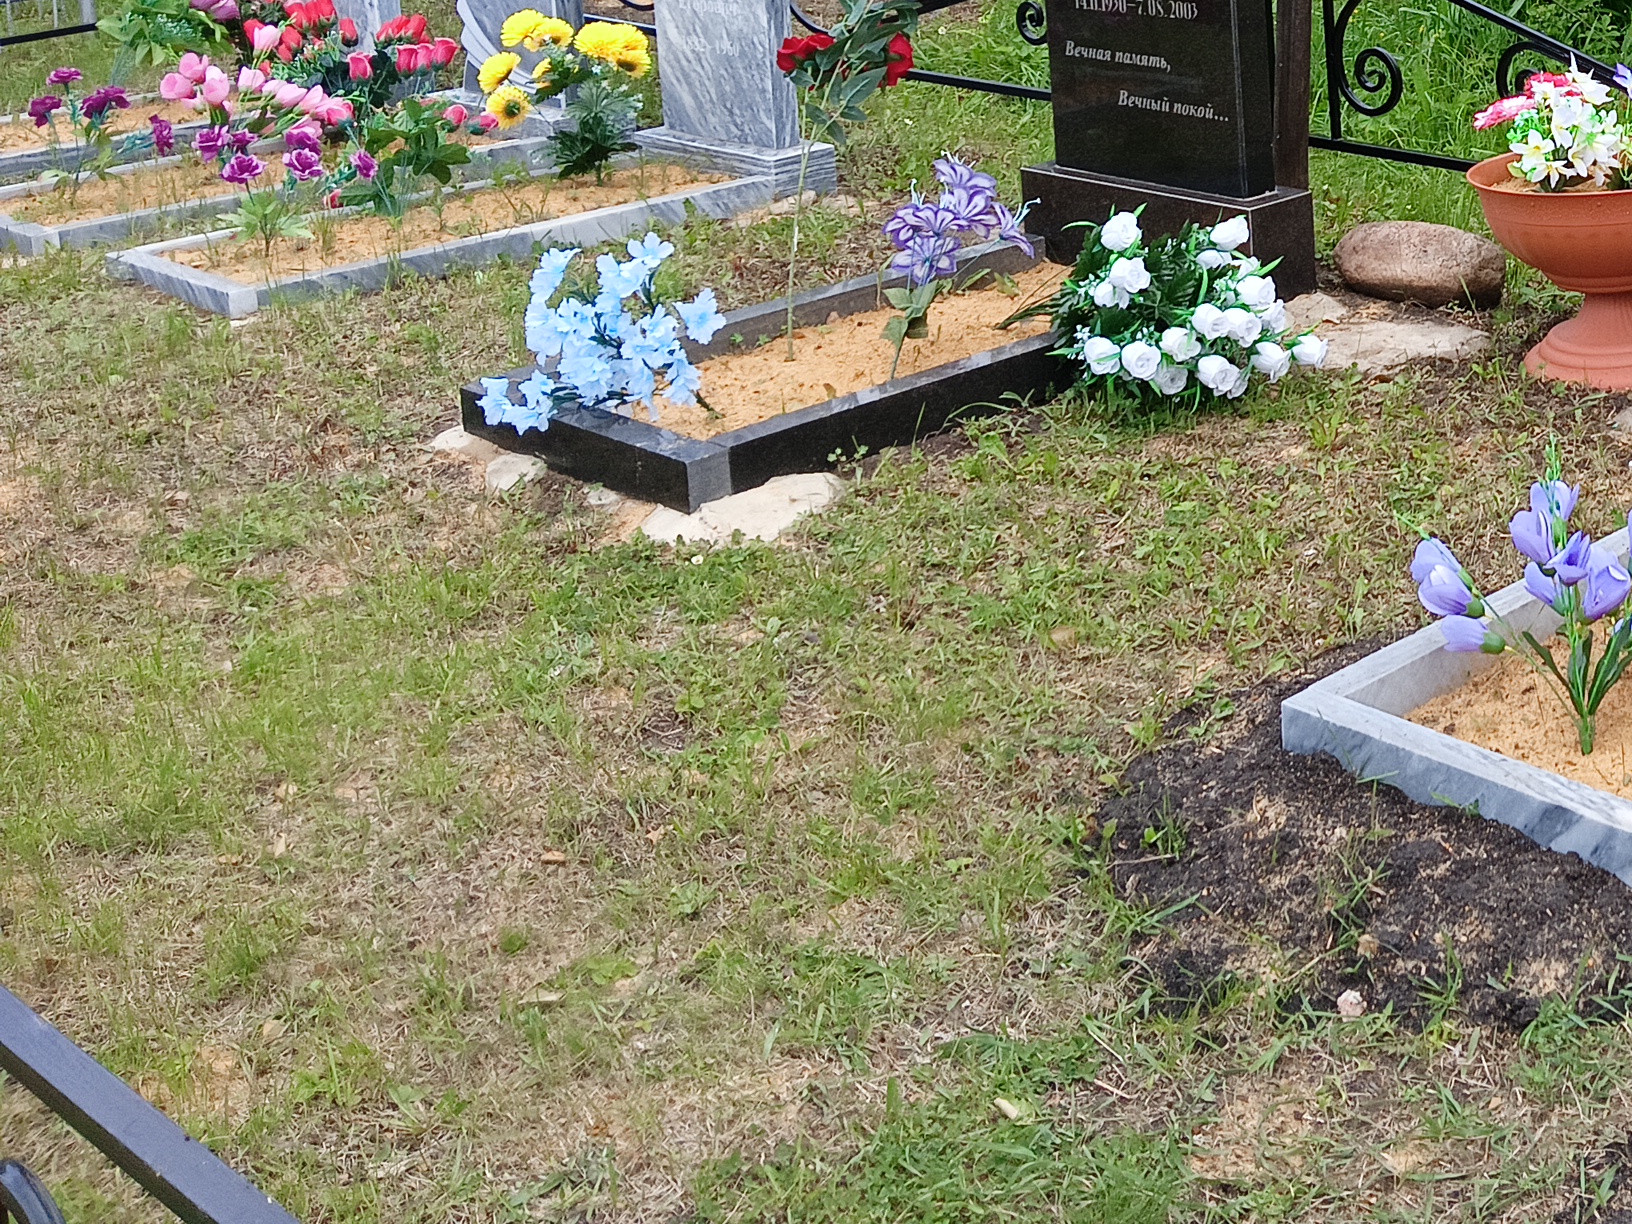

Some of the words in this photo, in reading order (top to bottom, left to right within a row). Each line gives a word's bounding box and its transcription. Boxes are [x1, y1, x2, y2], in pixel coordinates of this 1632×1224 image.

[1065, 40, 1111, 61] Вечная
[1115, 51, 1171, 72] память,
[1118, 90, 1170, 113] Вечный
[1173, 103, 1229, 122] покой...
